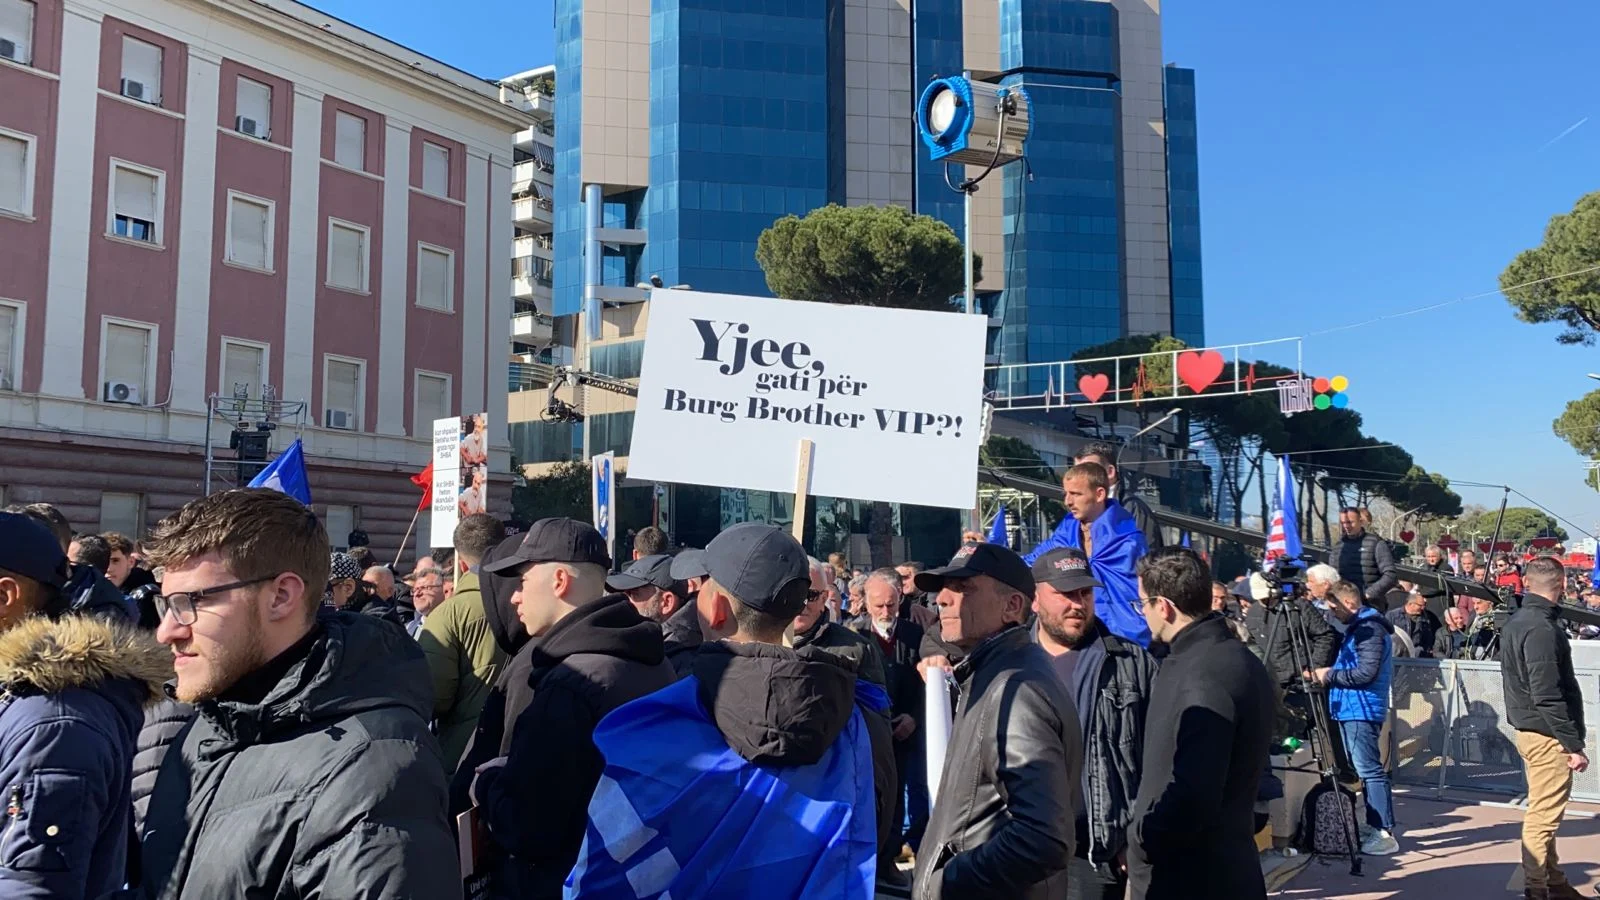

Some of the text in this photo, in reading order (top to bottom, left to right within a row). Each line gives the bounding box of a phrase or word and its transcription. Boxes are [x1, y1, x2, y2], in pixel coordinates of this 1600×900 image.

[689, 317, 825, 378] Yjee,
[755, 369, 868, 400] gati për
[662, 388, 963, 438] Burg Brother VIP?!
